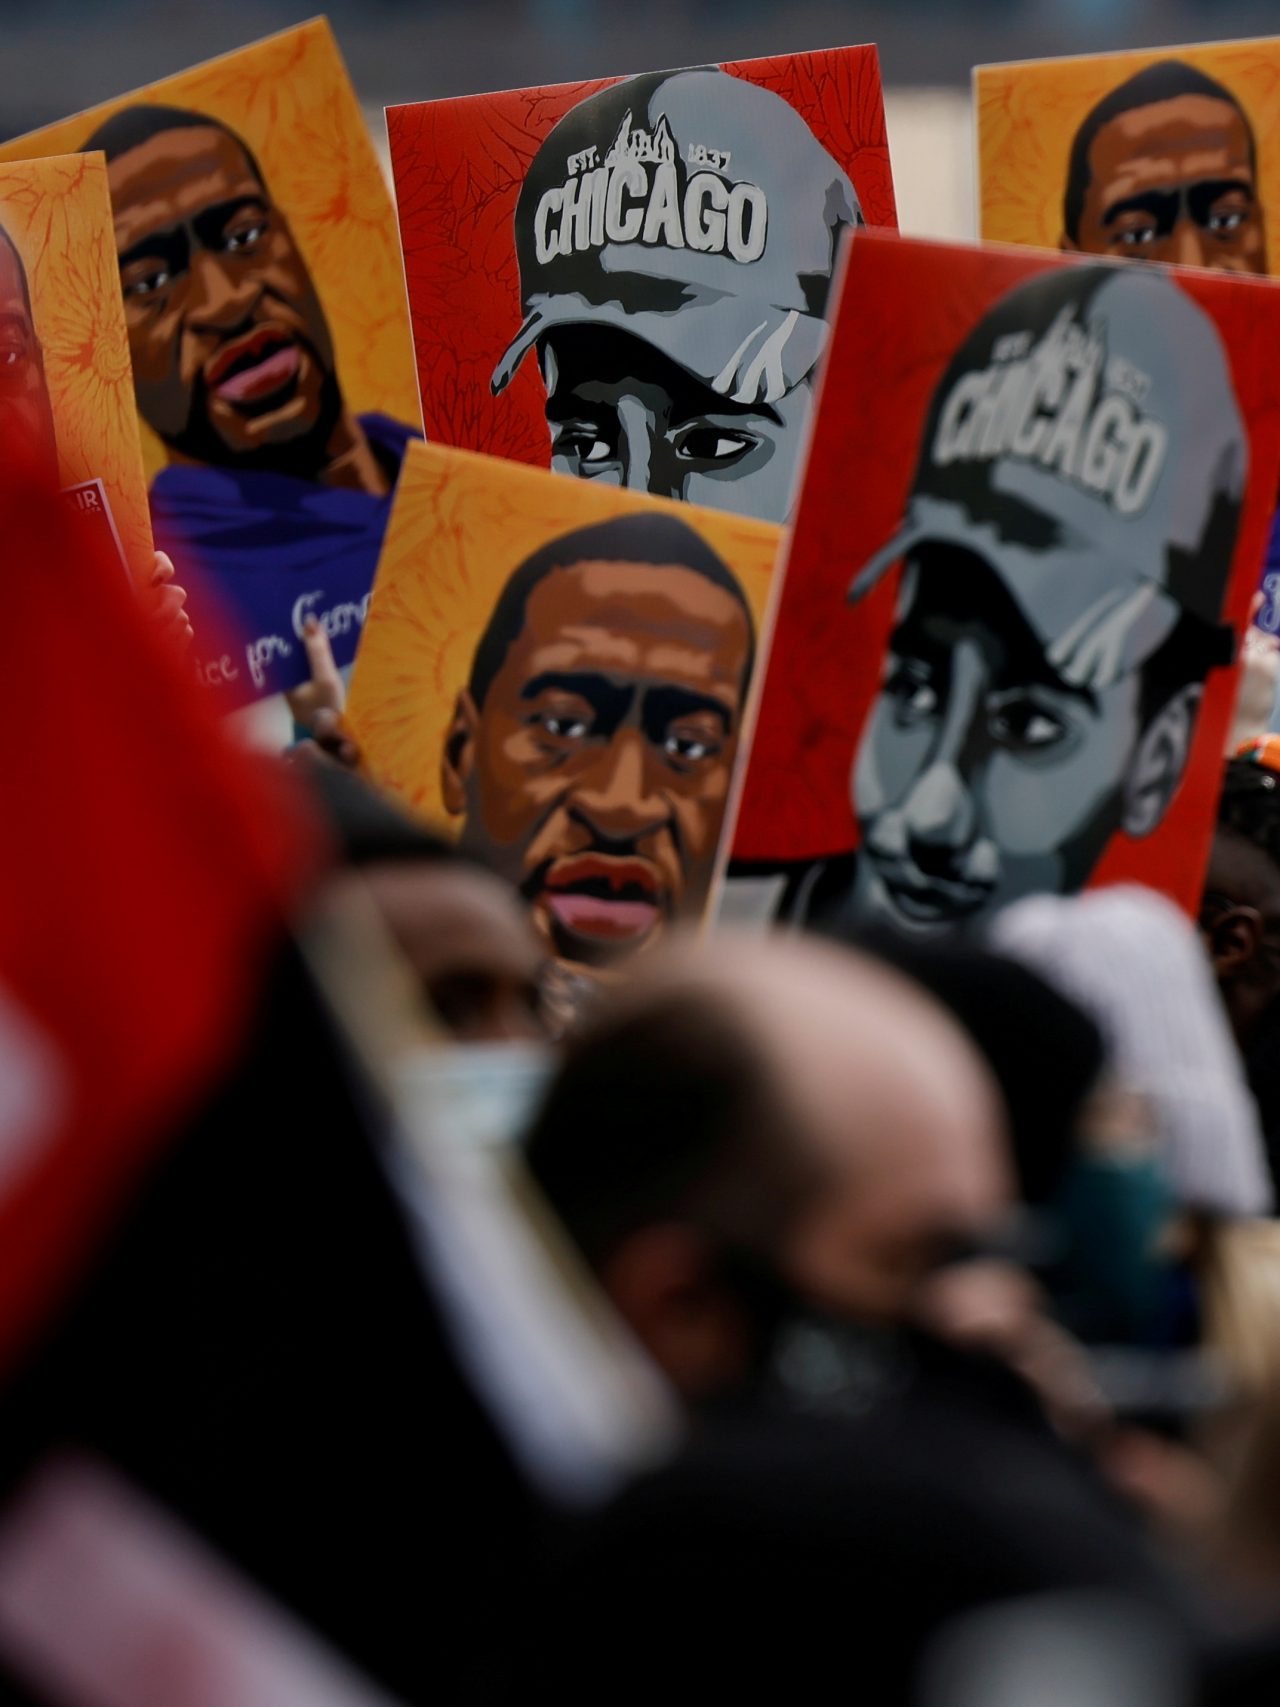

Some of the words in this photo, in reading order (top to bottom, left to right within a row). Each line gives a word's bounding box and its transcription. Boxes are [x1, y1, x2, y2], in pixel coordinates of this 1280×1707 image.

[687, 143, 731, 172] 1837
[534, 165, 768, 265] CHICAGO
[931, 352, 1168, 513] CHICAGO
